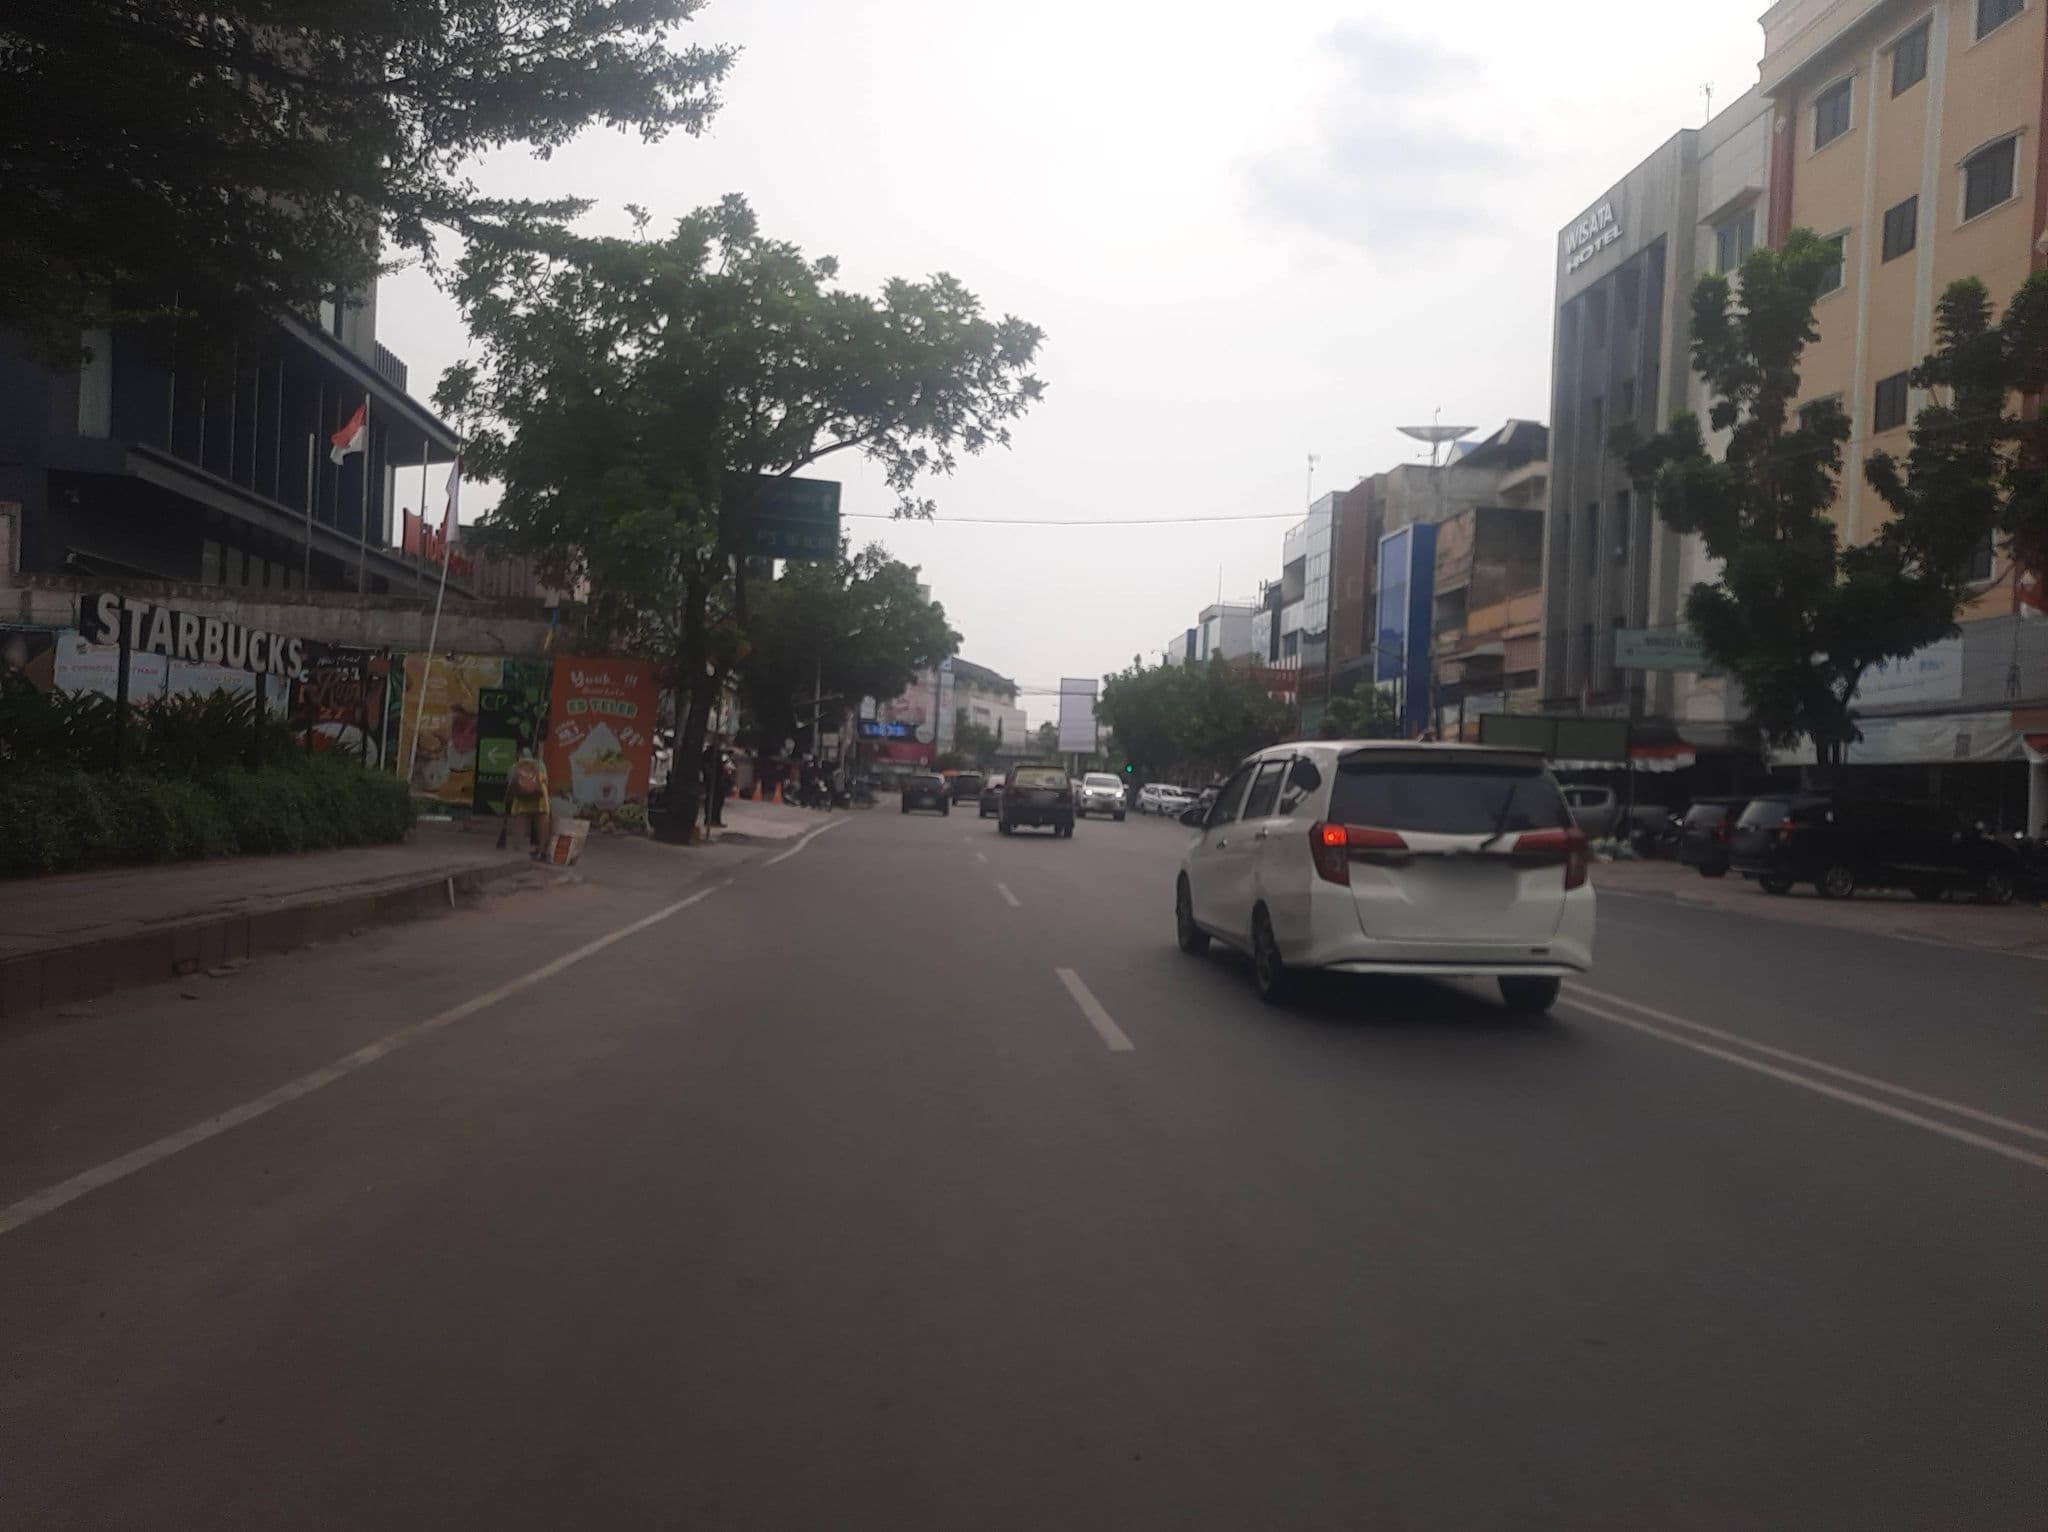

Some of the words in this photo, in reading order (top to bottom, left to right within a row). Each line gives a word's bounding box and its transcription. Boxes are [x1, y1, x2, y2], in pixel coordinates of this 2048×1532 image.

[1566, 202, 1614, 255] WISATA
[1566, 225, 1624, 275] HOTEL
[96, 592, 304, 678] STARBUCKS
